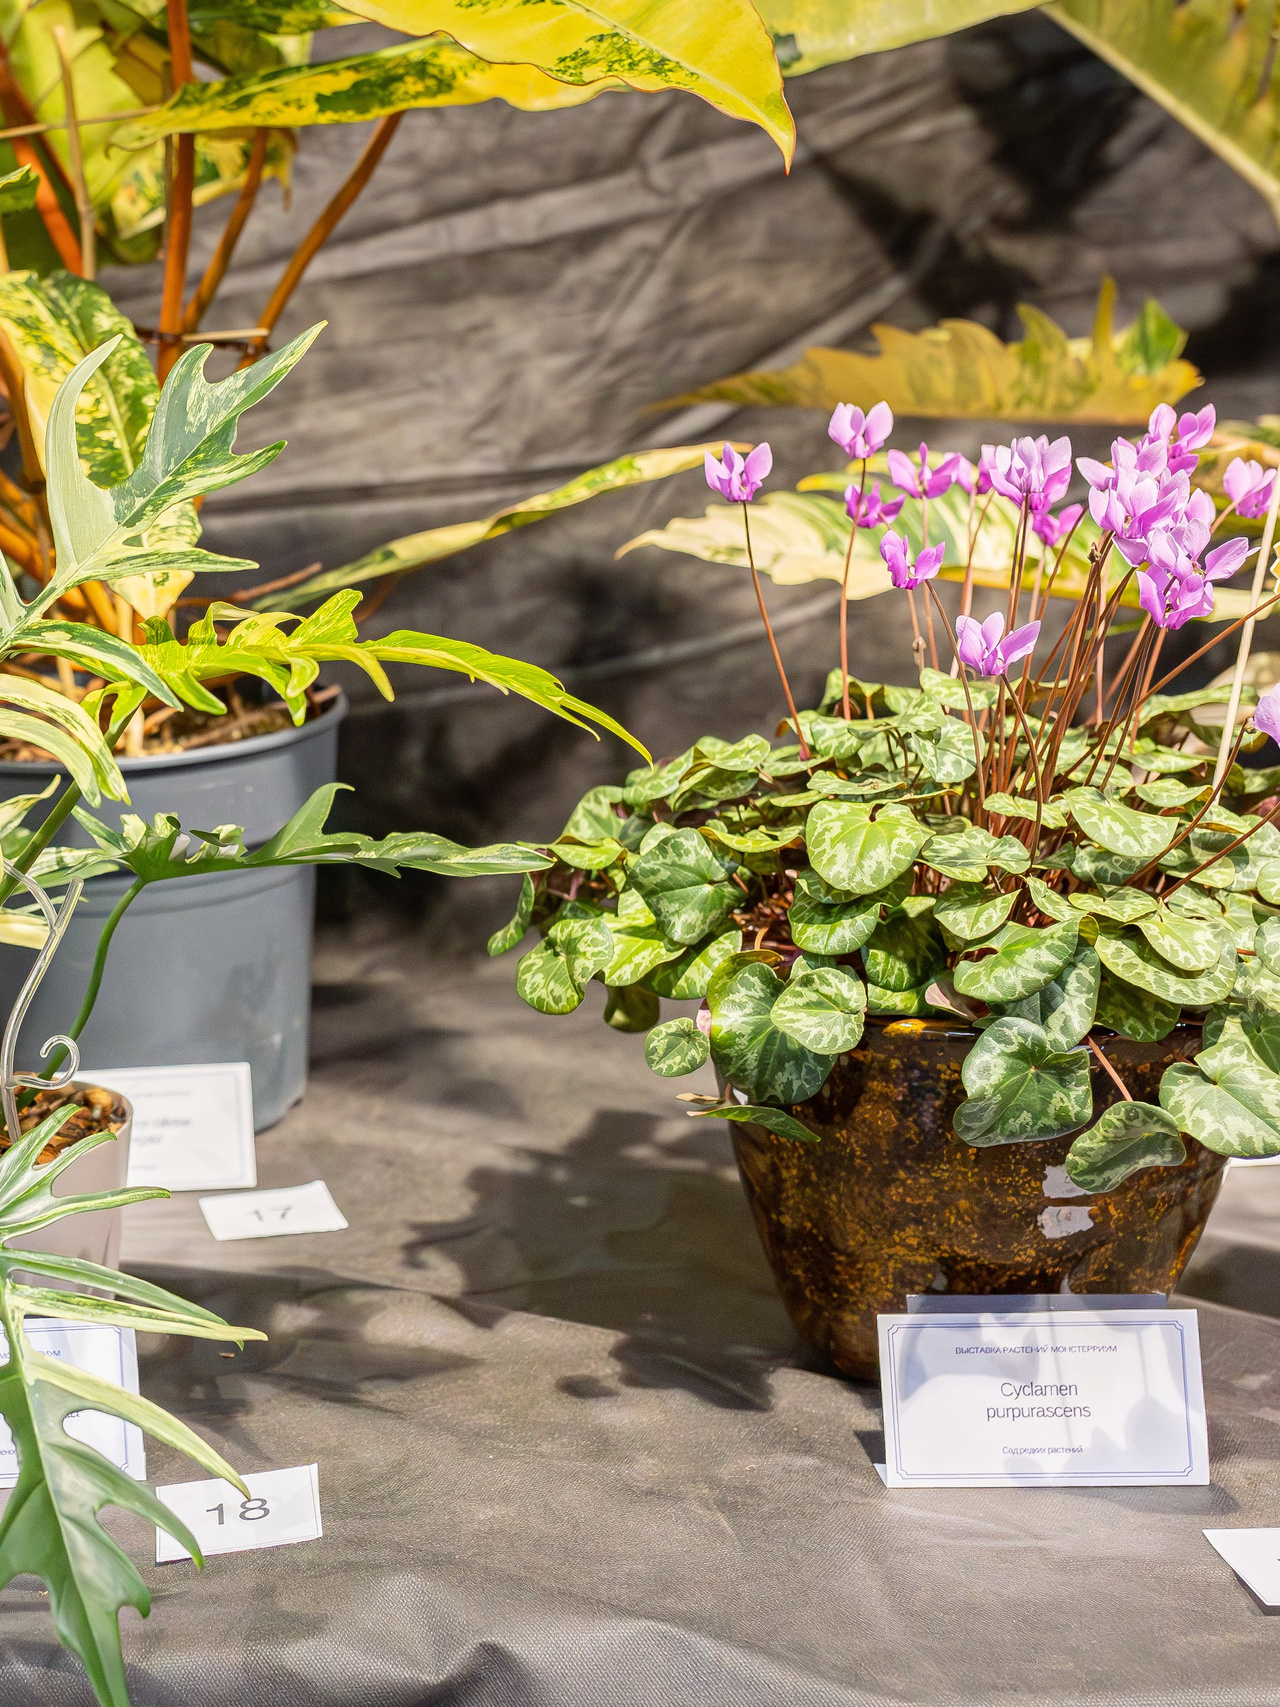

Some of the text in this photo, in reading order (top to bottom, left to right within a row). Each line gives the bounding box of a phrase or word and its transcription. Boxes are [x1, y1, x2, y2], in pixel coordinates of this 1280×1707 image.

[247, 1205, 293, 1222] 17
[955, 1345, 1118, 1355] ВЫСТАВКА РАСТЕНИЙ МОНСТЕРРИУМ
[1000, 1381, 1078, 1400] Cyclamen
[986, 1405, 1092, 1422] purpurascens
[1002, 1446, 1019, 1455] Сад
[1048, 1445, 1084, 1455] растений
[205, 1498, 270, 1525] 18
